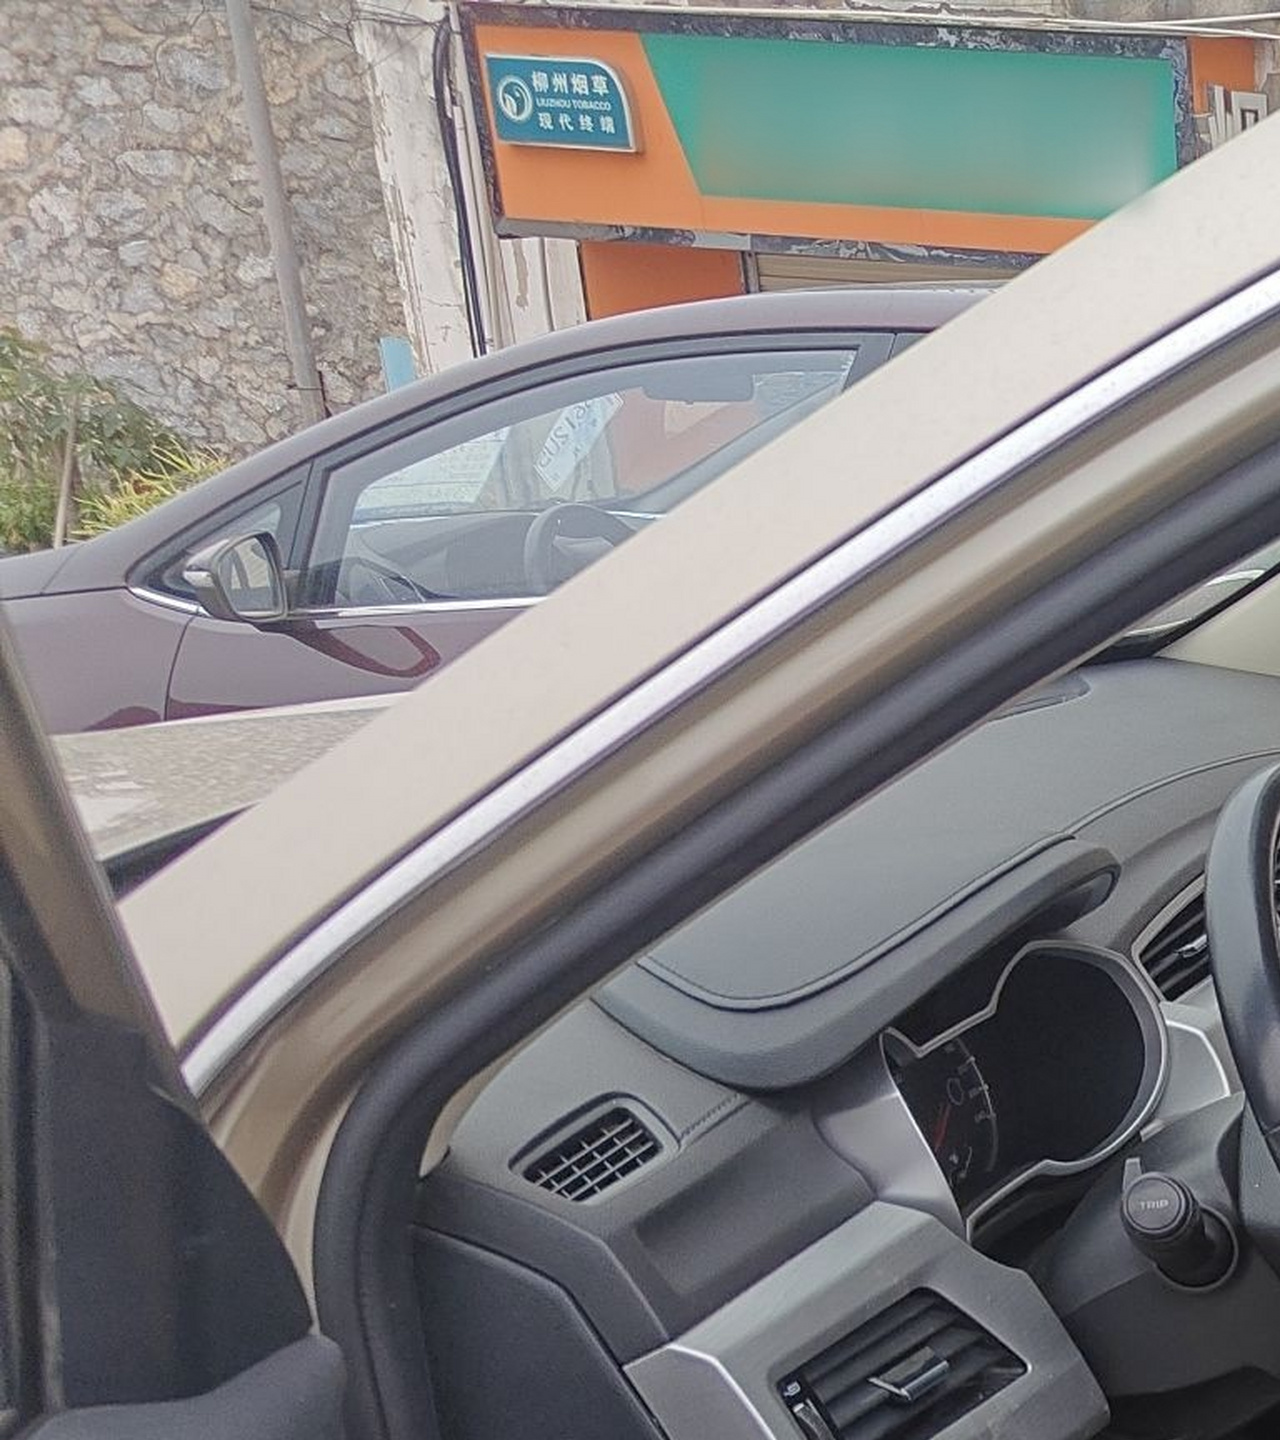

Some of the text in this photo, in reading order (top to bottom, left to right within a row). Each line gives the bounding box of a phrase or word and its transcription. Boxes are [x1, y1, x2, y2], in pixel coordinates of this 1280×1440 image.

[532, 71, 609, 96] 柳州烟草
[536, 98, 611, 111] LIUZHOU TOBACCO
[538, 112, 615, 134] 现代终端
[1140, 1200, 1169, 1210] TRIP
